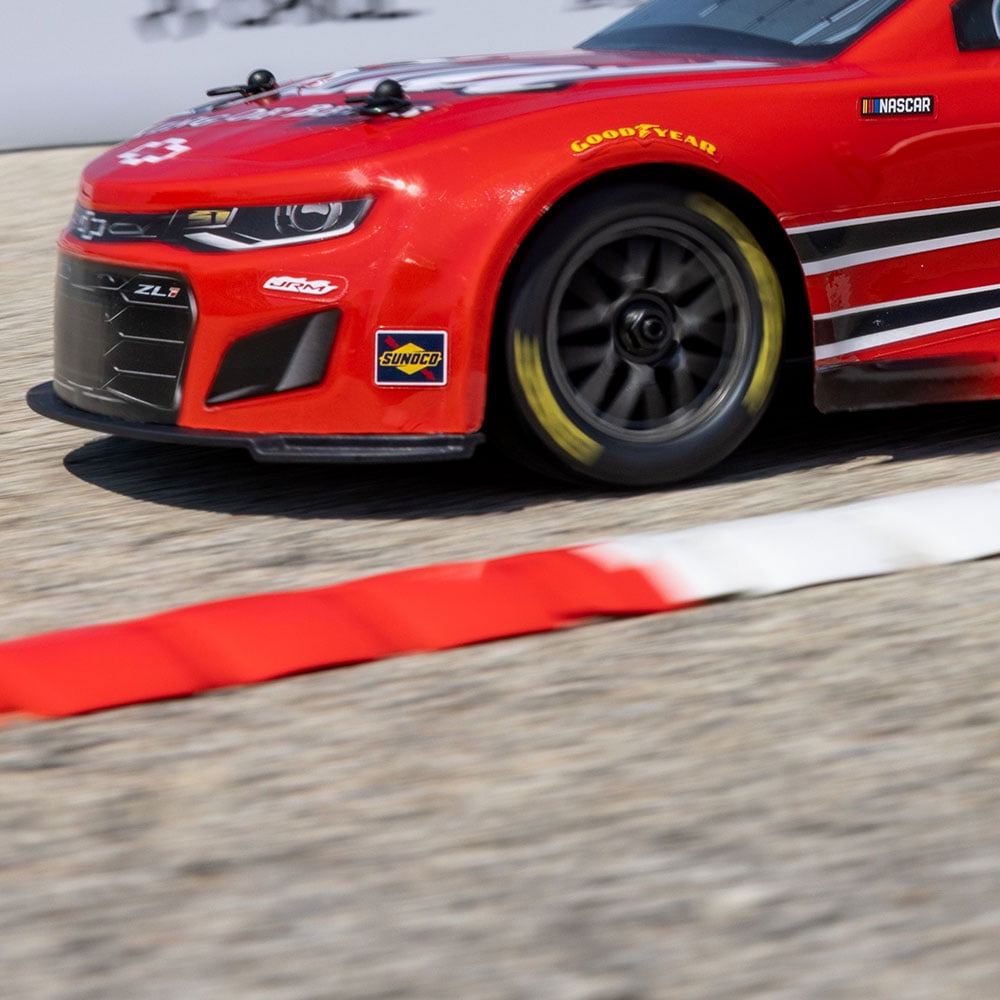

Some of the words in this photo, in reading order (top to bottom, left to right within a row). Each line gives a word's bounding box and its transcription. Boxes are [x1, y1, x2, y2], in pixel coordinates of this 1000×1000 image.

[879, 97, 931, 114] NASCAR
[134, 284, 181, 299] ZL1
[269, 281, 327, 293] JRM
[382, 350, 442, 366] SUNOCO
